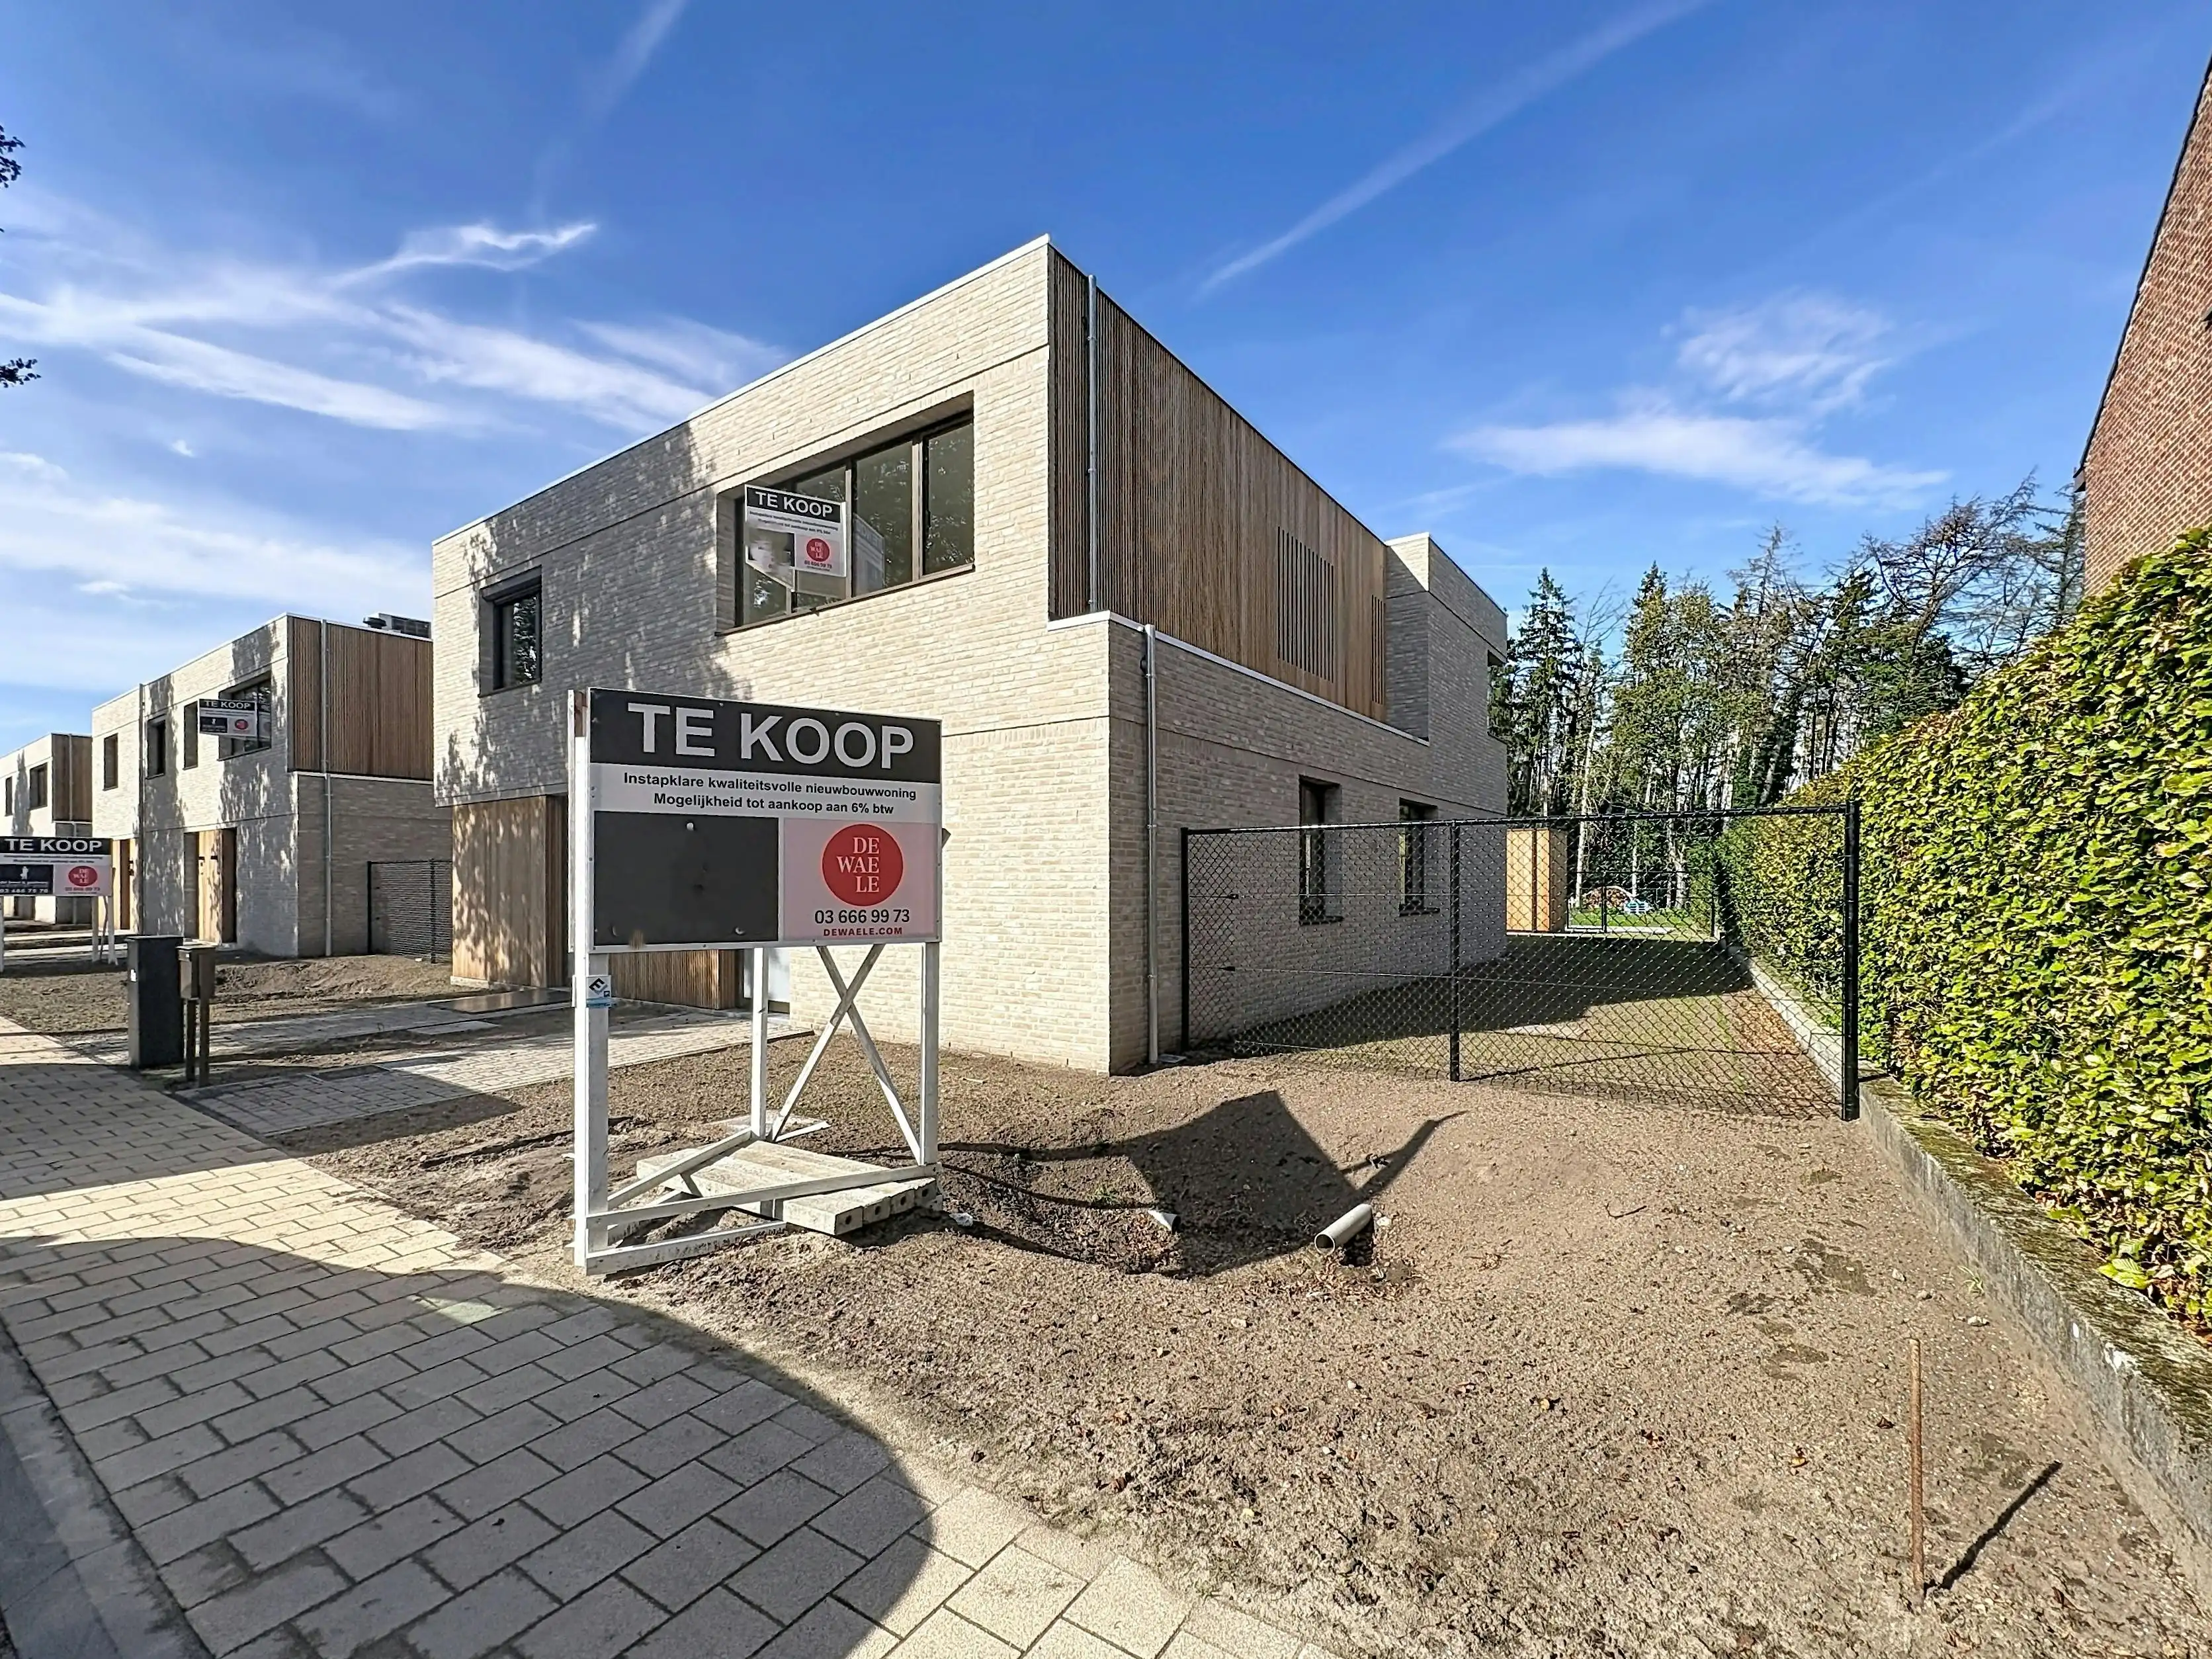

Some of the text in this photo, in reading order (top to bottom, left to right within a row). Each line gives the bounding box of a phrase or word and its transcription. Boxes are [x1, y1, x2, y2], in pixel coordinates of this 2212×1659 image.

[755, 491, 778, 508] TE
[784, 496, 833, 517] KOOP
[627, 702, 914, 770] TE KOOP
[624, 772, 917, 801] Instapklare kwaliteitsvolle nieuwbouwwoning
[654, 792, 894, 814] Mogelijkheid tot aankoop aan 6% btw
[4, 838, 102, 852] TE KOOP
[853, 837, 880, 854] DE
[836, 856, 880, 874] WAE
[855, 876, 880, 893] LE
[814, 909, 910, 924] 03 666 99 73
[823, 927, 902, 937] DEWAELE.COM
